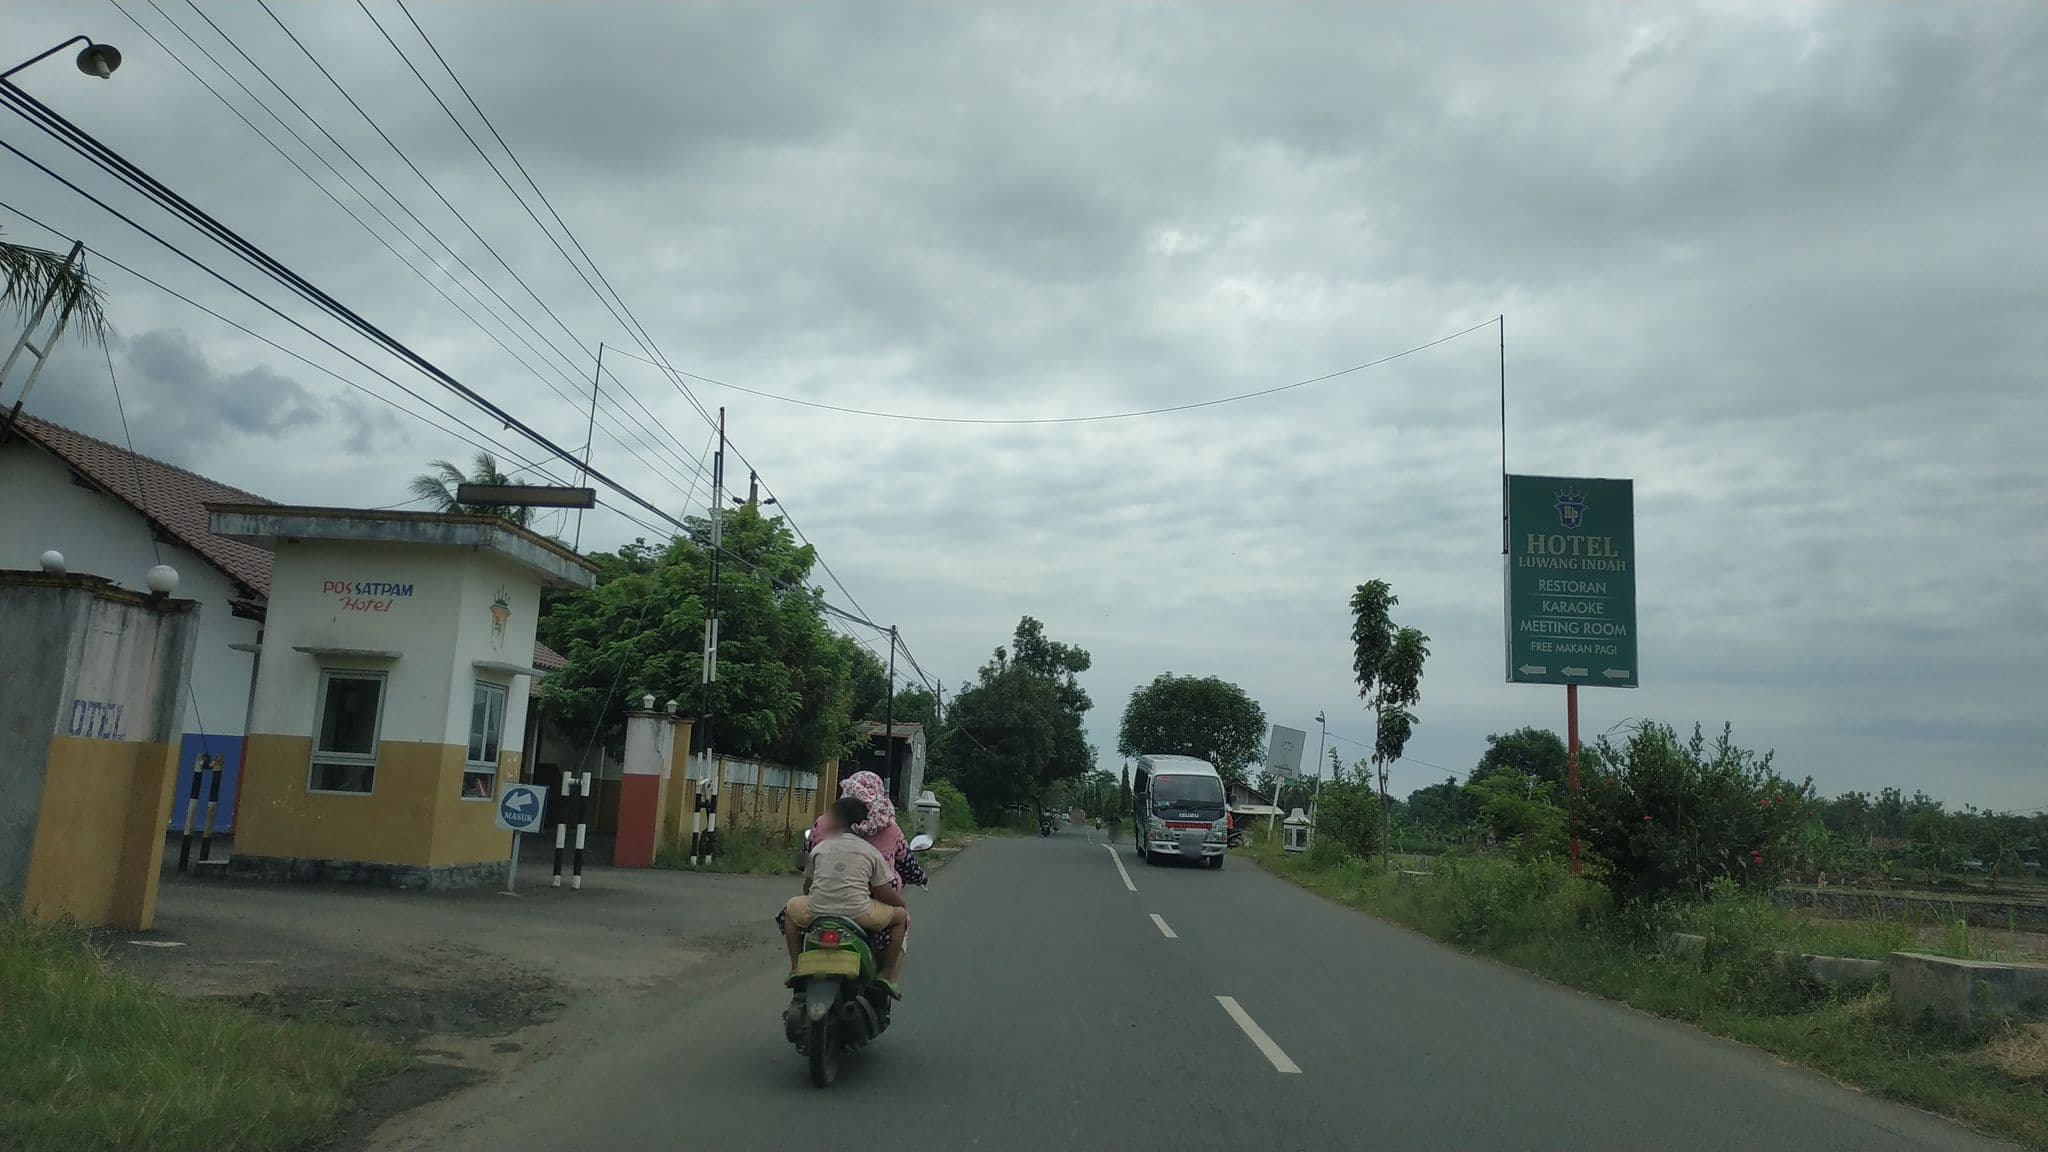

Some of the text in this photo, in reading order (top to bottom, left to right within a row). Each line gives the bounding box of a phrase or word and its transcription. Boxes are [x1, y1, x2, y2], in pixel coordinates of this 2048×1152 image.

[1526, 533, 1618, 557] HOTEL
[1519, 556, 1626, 571] LUWANG INDAH
[323, 581, 414, 596] POS SATPAM
[1538, 579, 1607, 594] RESTORAN
[339, 597, 394, 612] Hotel
[1542, 600, 1604, 615] KARAOKE
[1520, 620, 1627, 636] MEETING ROOM
[1531, 641, 1617, 655] FREE MAKAN PAGI
[504, 811, 534, 822] MASUK
